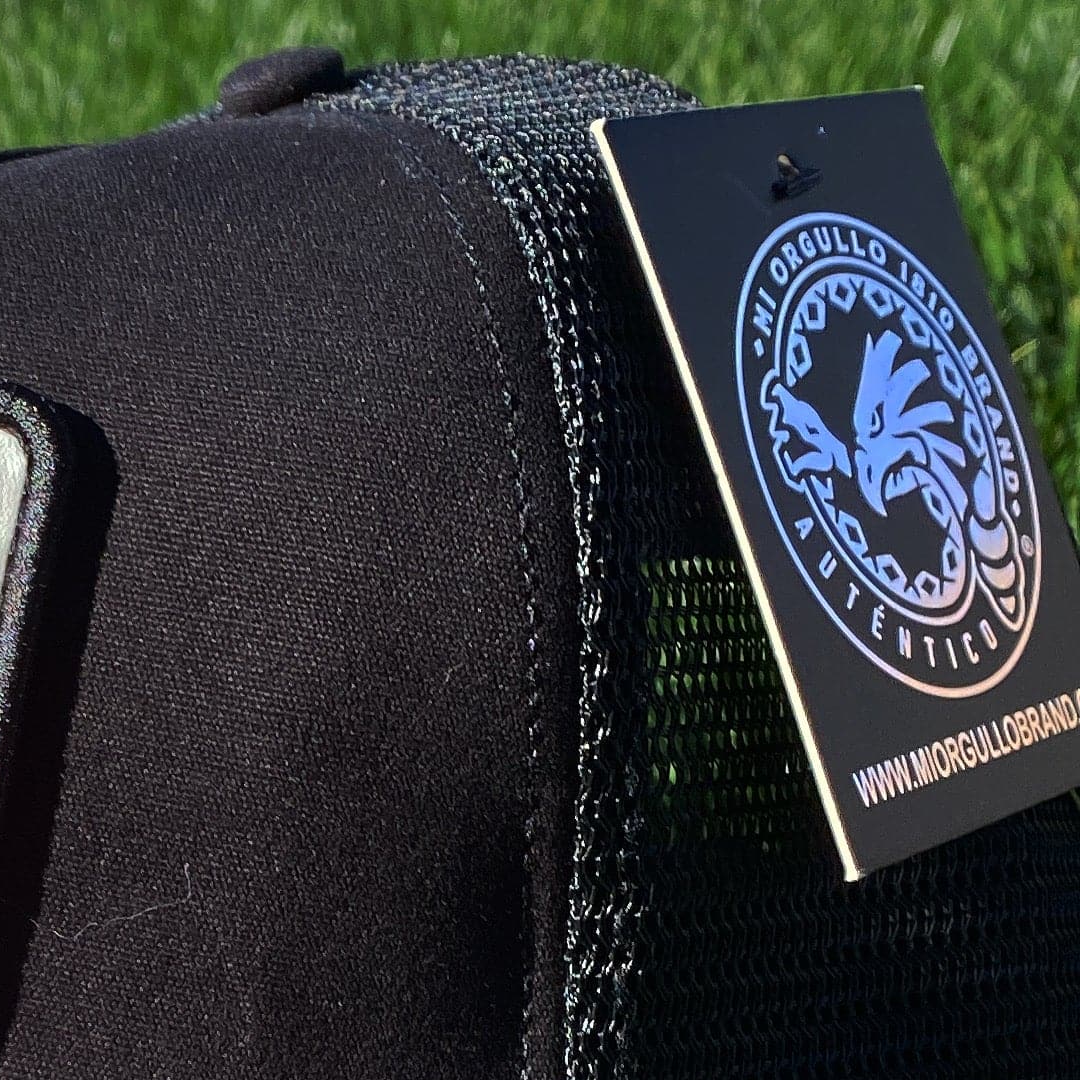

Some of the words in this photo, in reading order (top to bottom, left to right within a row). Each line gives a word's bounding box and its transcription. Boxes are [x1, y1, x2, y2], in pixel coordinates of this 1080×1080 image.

[752, 286, 777, 337] MI
[770, 226, 887, 285] ORGULLO
[900, 261, 956, 333] 1810
[961, 344, 1019, 493] BRAND
[794, 516, 999, 670] AUTÉNTICO
